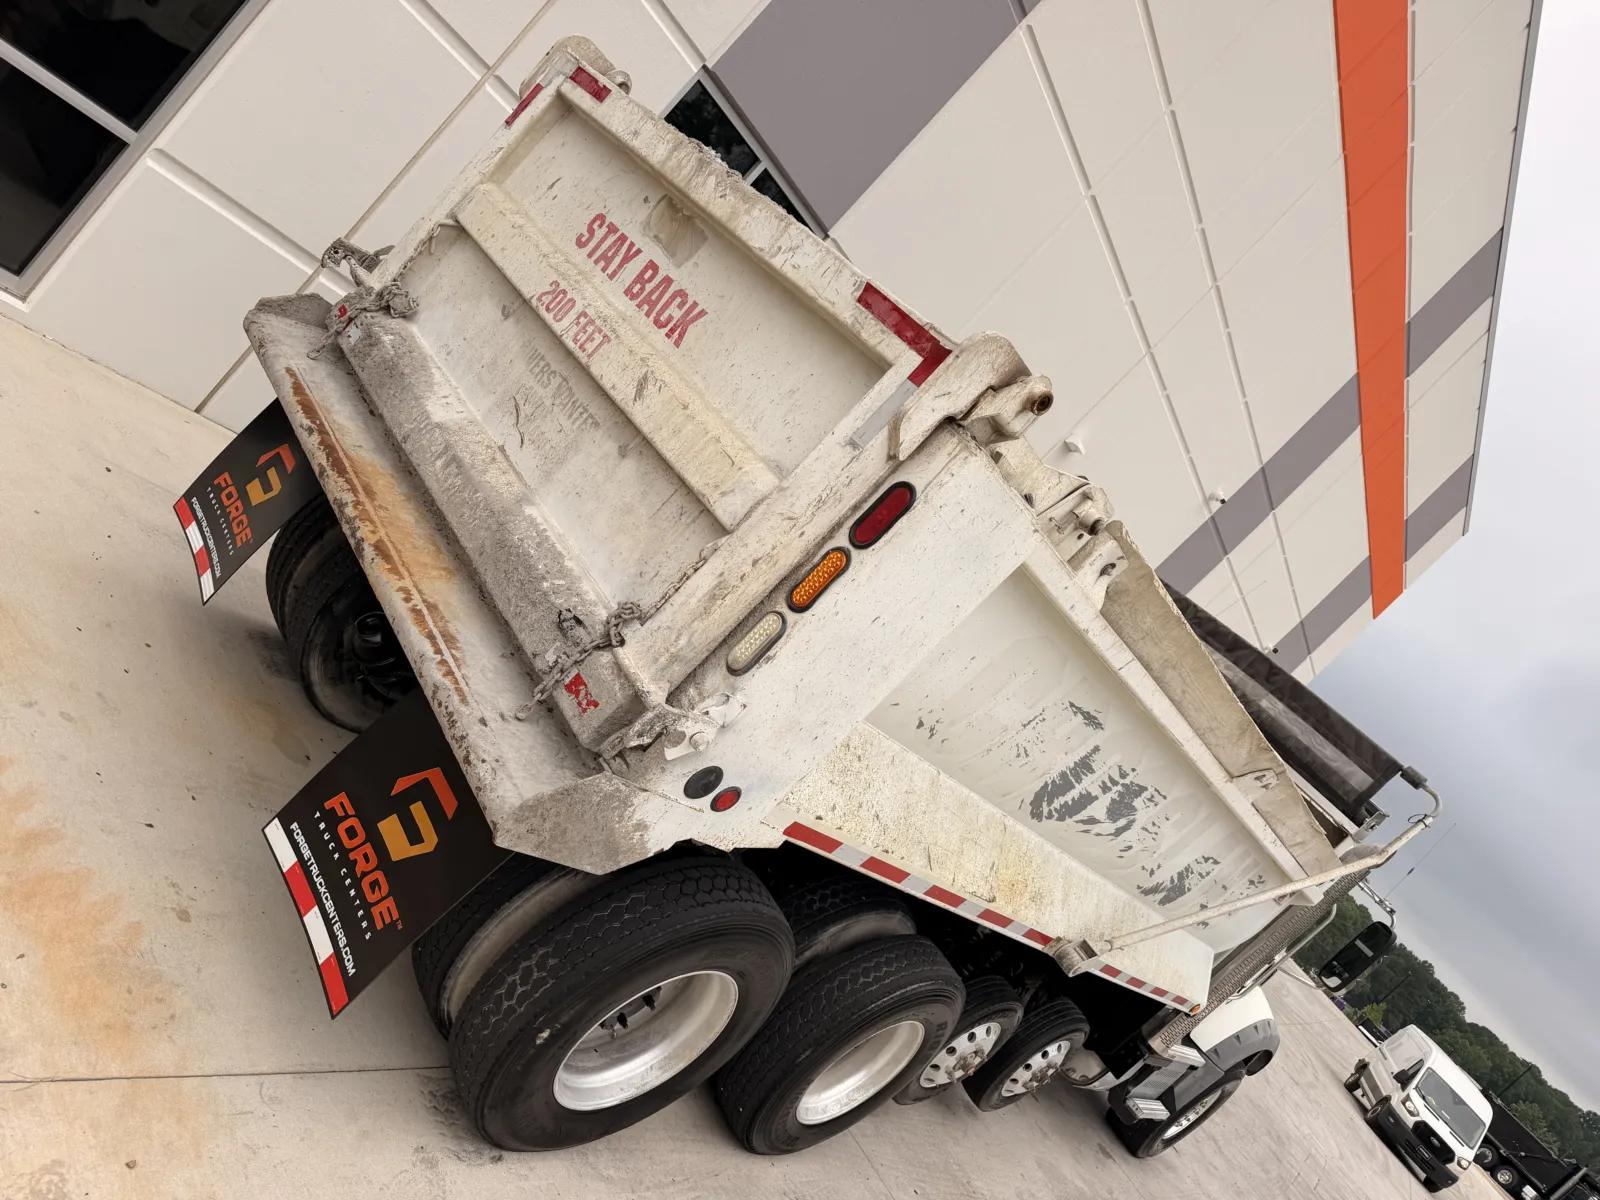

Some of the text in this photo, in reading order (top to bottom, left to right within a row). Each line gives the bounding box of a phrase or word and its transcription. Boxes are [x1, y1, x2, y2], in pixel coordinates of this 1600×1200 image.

[536, 280, 612, 360] 200 FEET
[575, 213, 709, 349] STAY BACK
[190, 496, 222, 579] FORGETRUCKCENTERS.COM
[206, 486, 234, 556] TRUCK CENTERS
[213, 471, 253, 549] FORGE
[289, 821, 356, 977] FORGETRUCKCENTERS.COM
[314, 811, 372, 940] TRUCK CENTERS
[323, 791, 399, 930] FORGE
